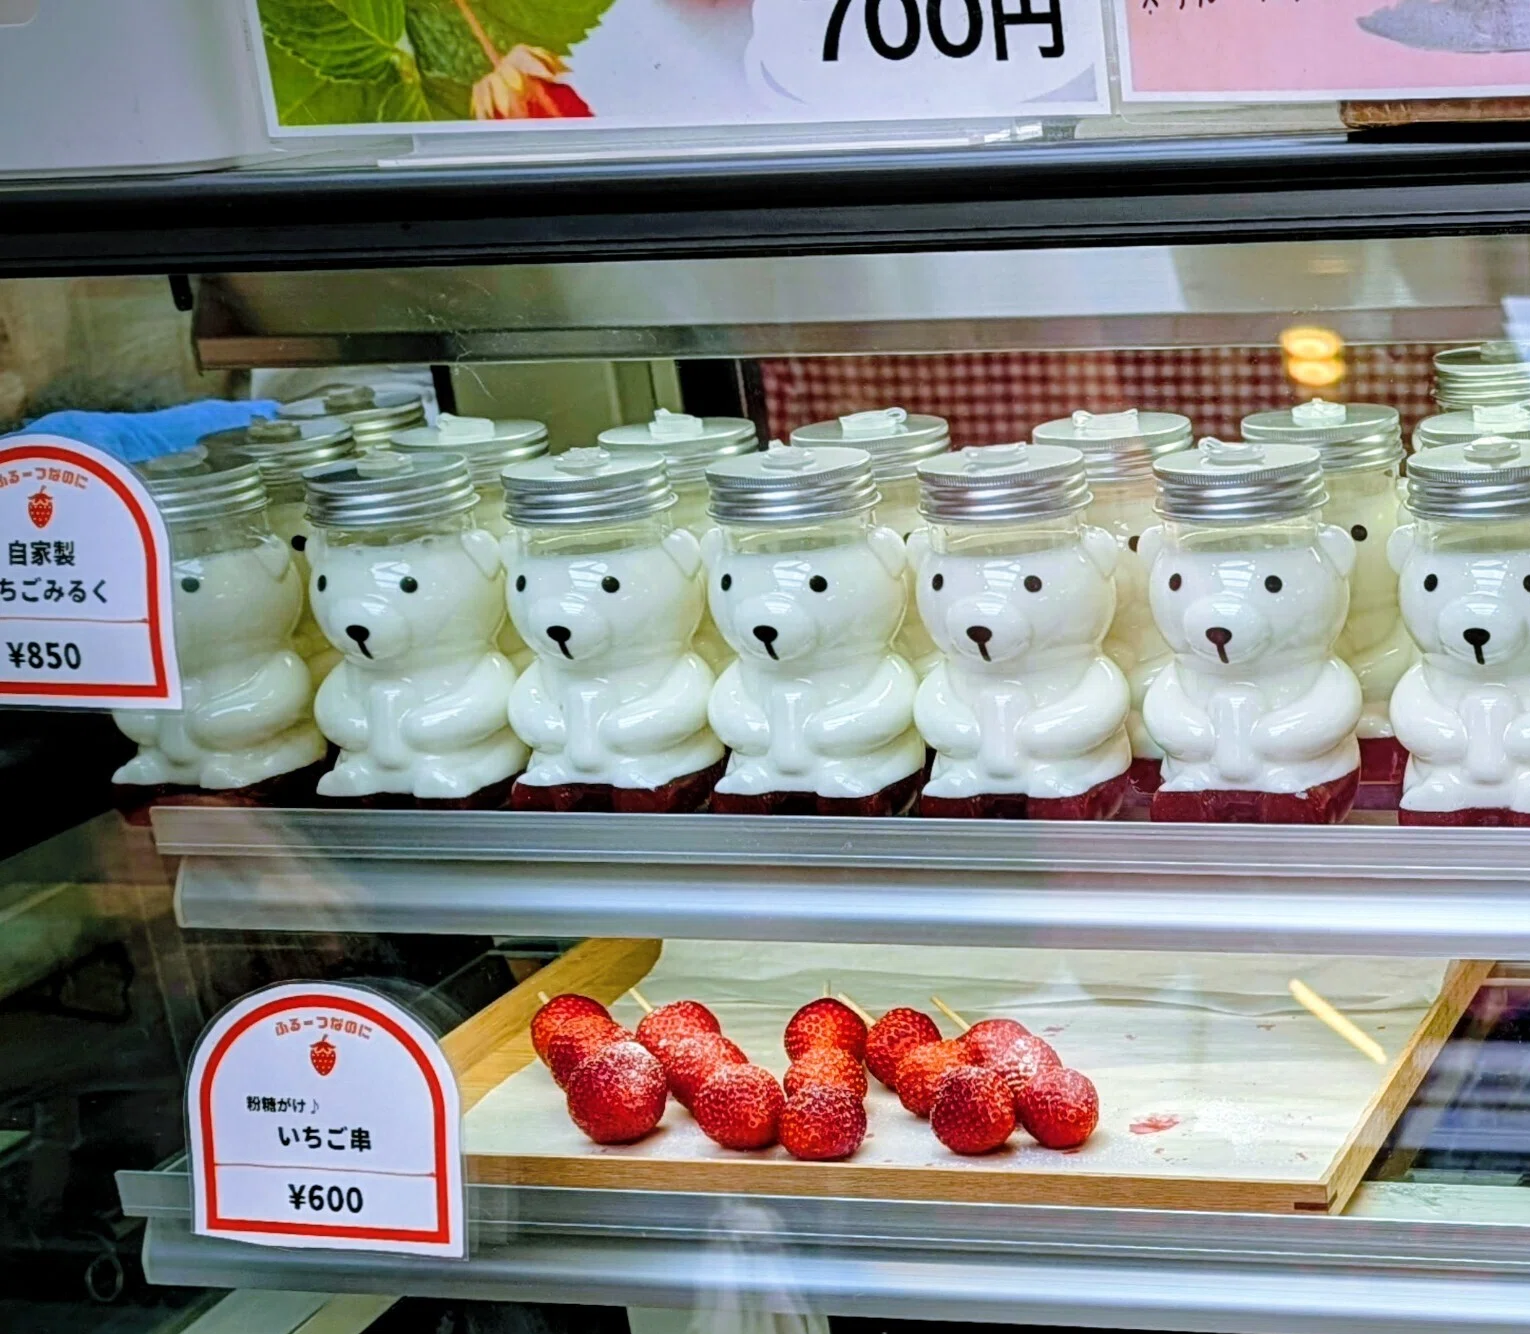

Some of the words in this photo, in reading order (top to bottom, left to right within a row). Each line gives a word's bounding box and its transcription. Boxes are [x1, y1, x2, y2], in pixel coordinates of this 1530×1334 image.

[822, 0, 1065, 62] 700円
[8, 539, 75, 567] 自家製
[5, 641, 82, 670] ¥850
[275, 1016, 373, 1040] ふるーつなのに
[277, 1125, 372, 1153] いちご串
[287, 1183, 364, 1214] ¥600
